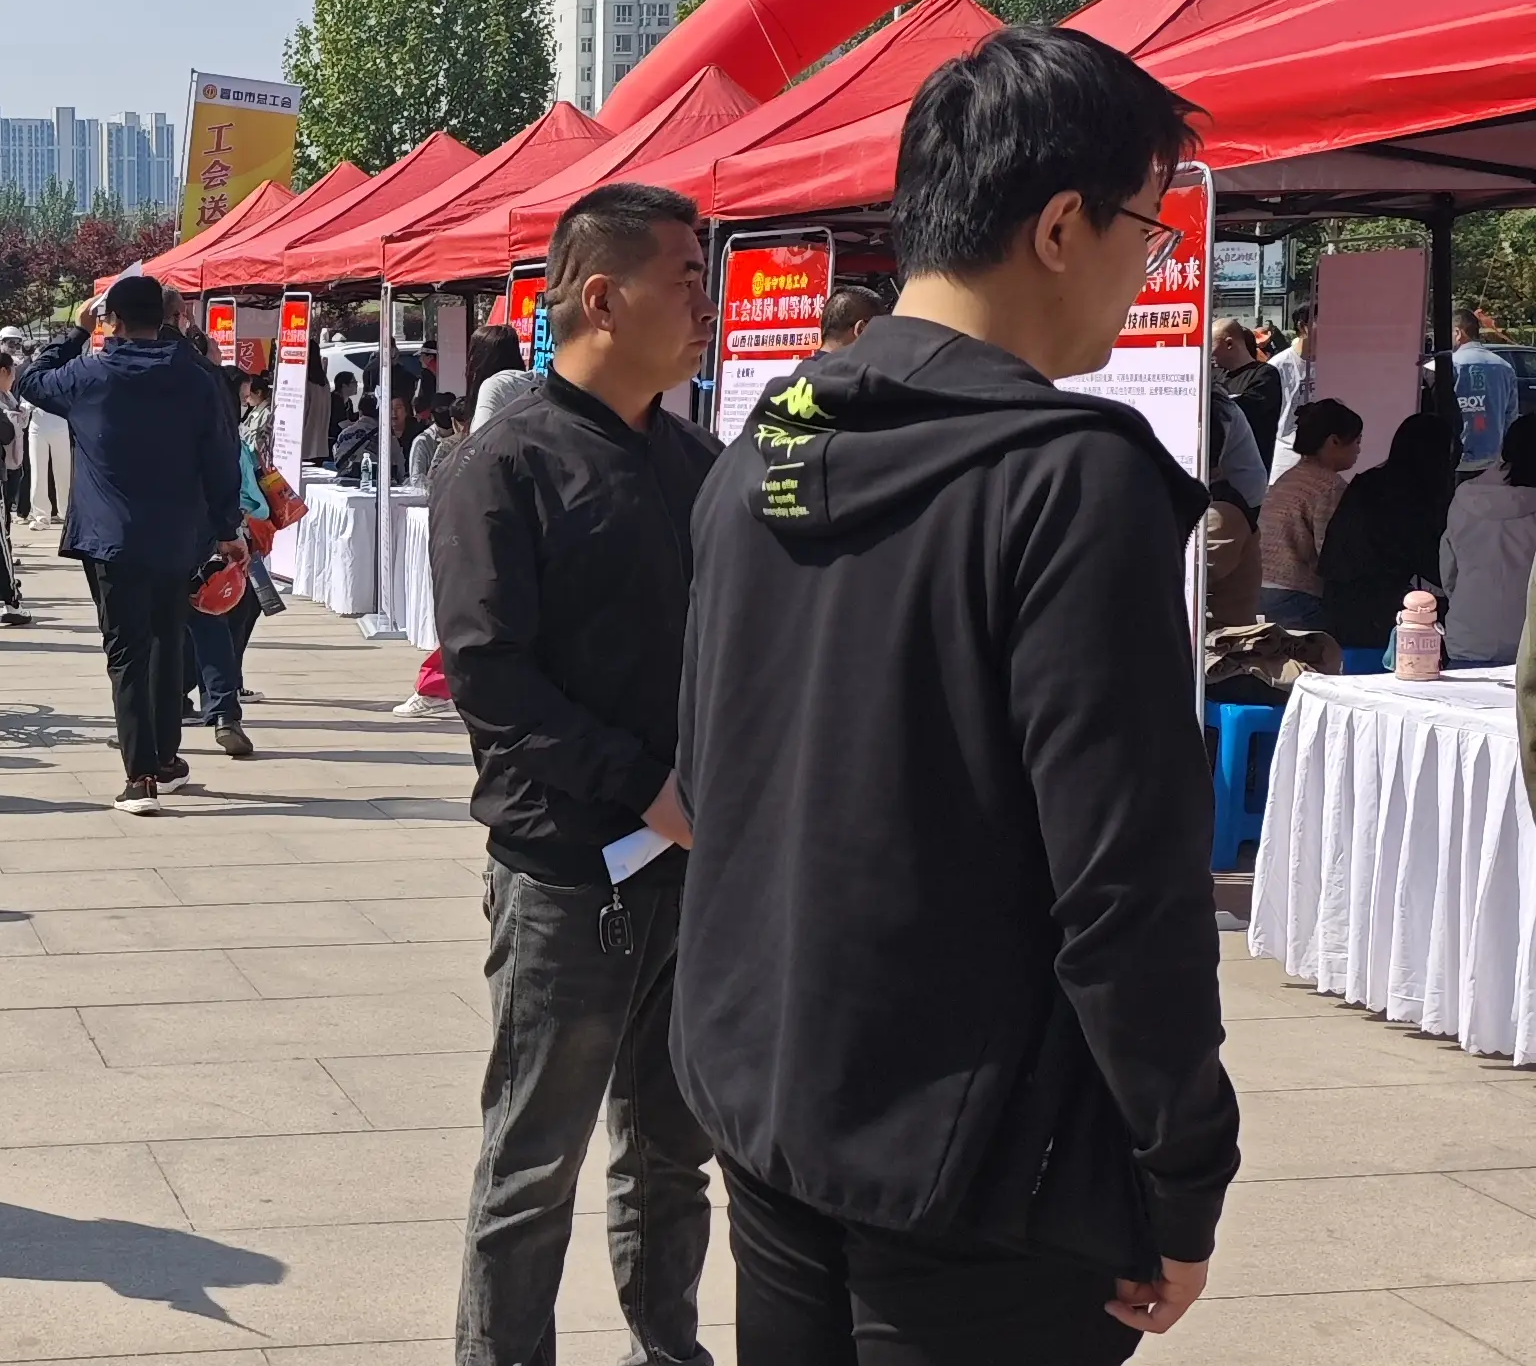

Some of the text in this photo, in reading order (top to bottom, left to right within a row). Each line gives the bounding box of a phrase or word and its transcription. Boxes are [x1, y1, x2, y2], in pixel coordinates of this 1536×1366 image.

[220, 88, 292, 109] 晋中市总工会
[196, 122, 234, 227] 工会送
[764, 272, 809, 291] 晋中市总工会
[728, 293, 825, 323] 工会送岗·职等你来
[1457, 395, 1485, 409] BOY
